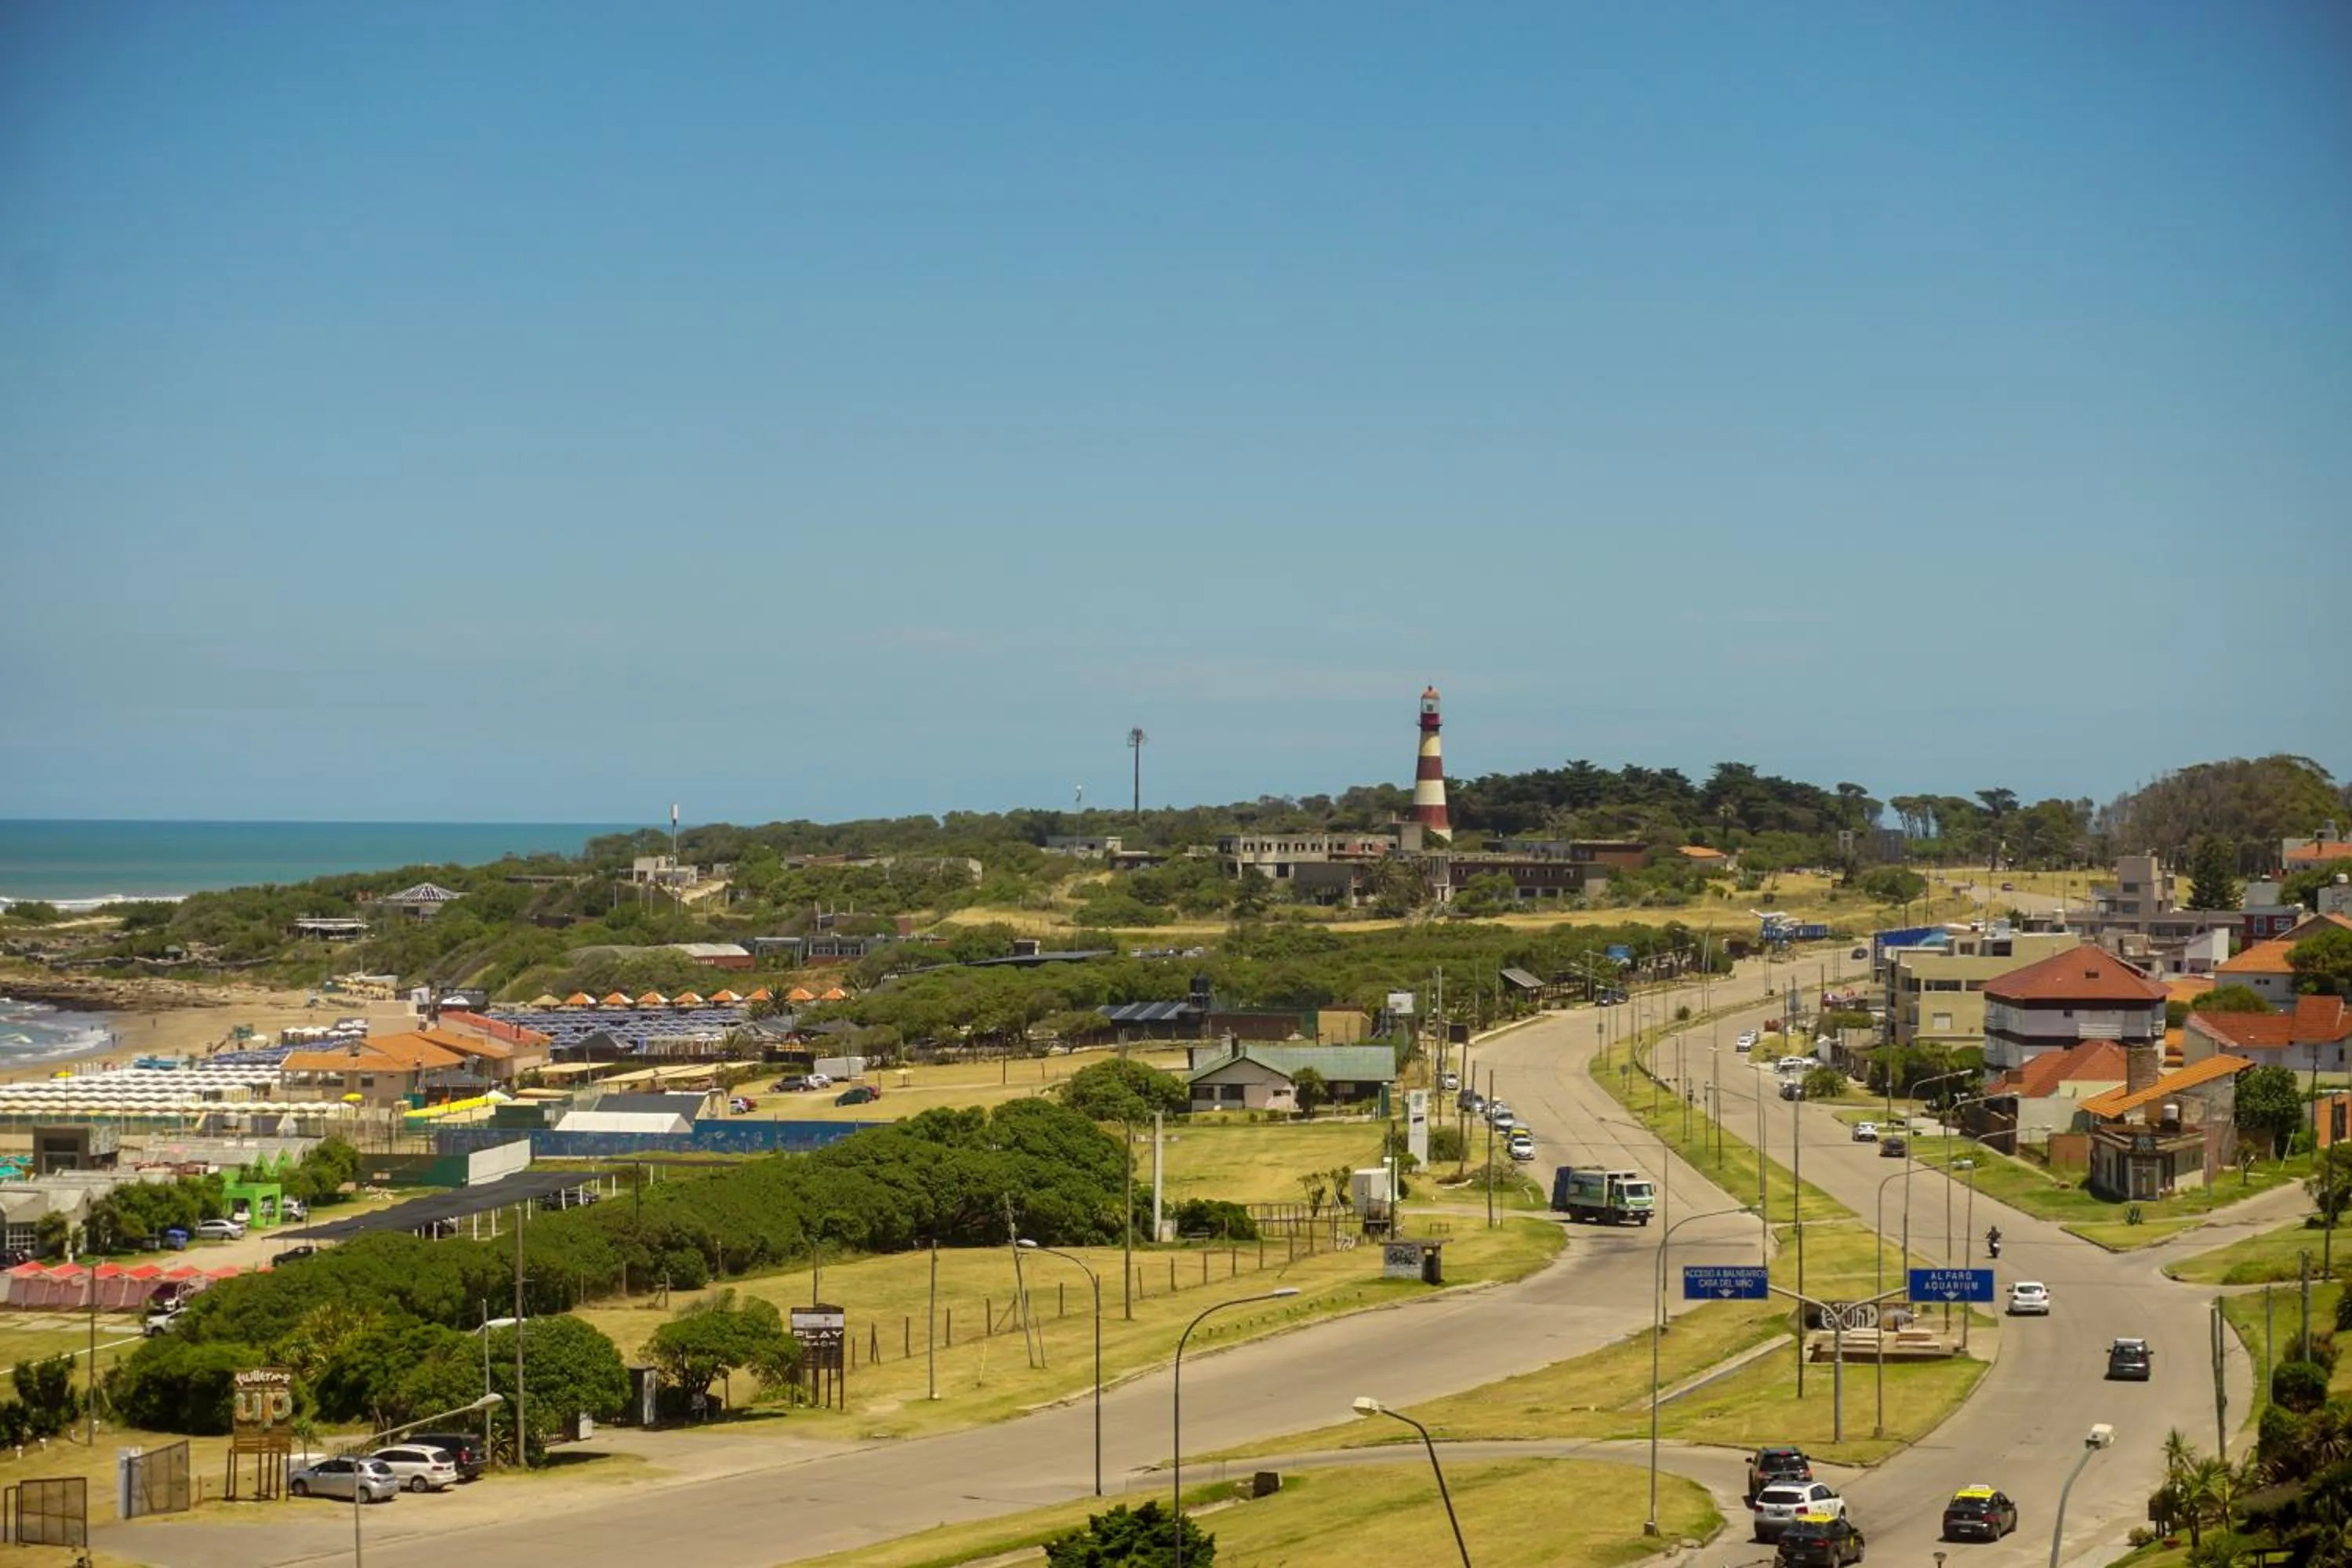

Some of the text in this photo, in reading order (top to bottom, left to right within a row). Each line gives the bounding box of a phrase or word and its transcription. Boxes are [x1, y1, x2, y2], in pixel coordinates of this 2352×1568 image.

[1930, 1271, 1973, 1280] AL FARO
[1924, 1281, 1979, 1290] AQUARIUM
